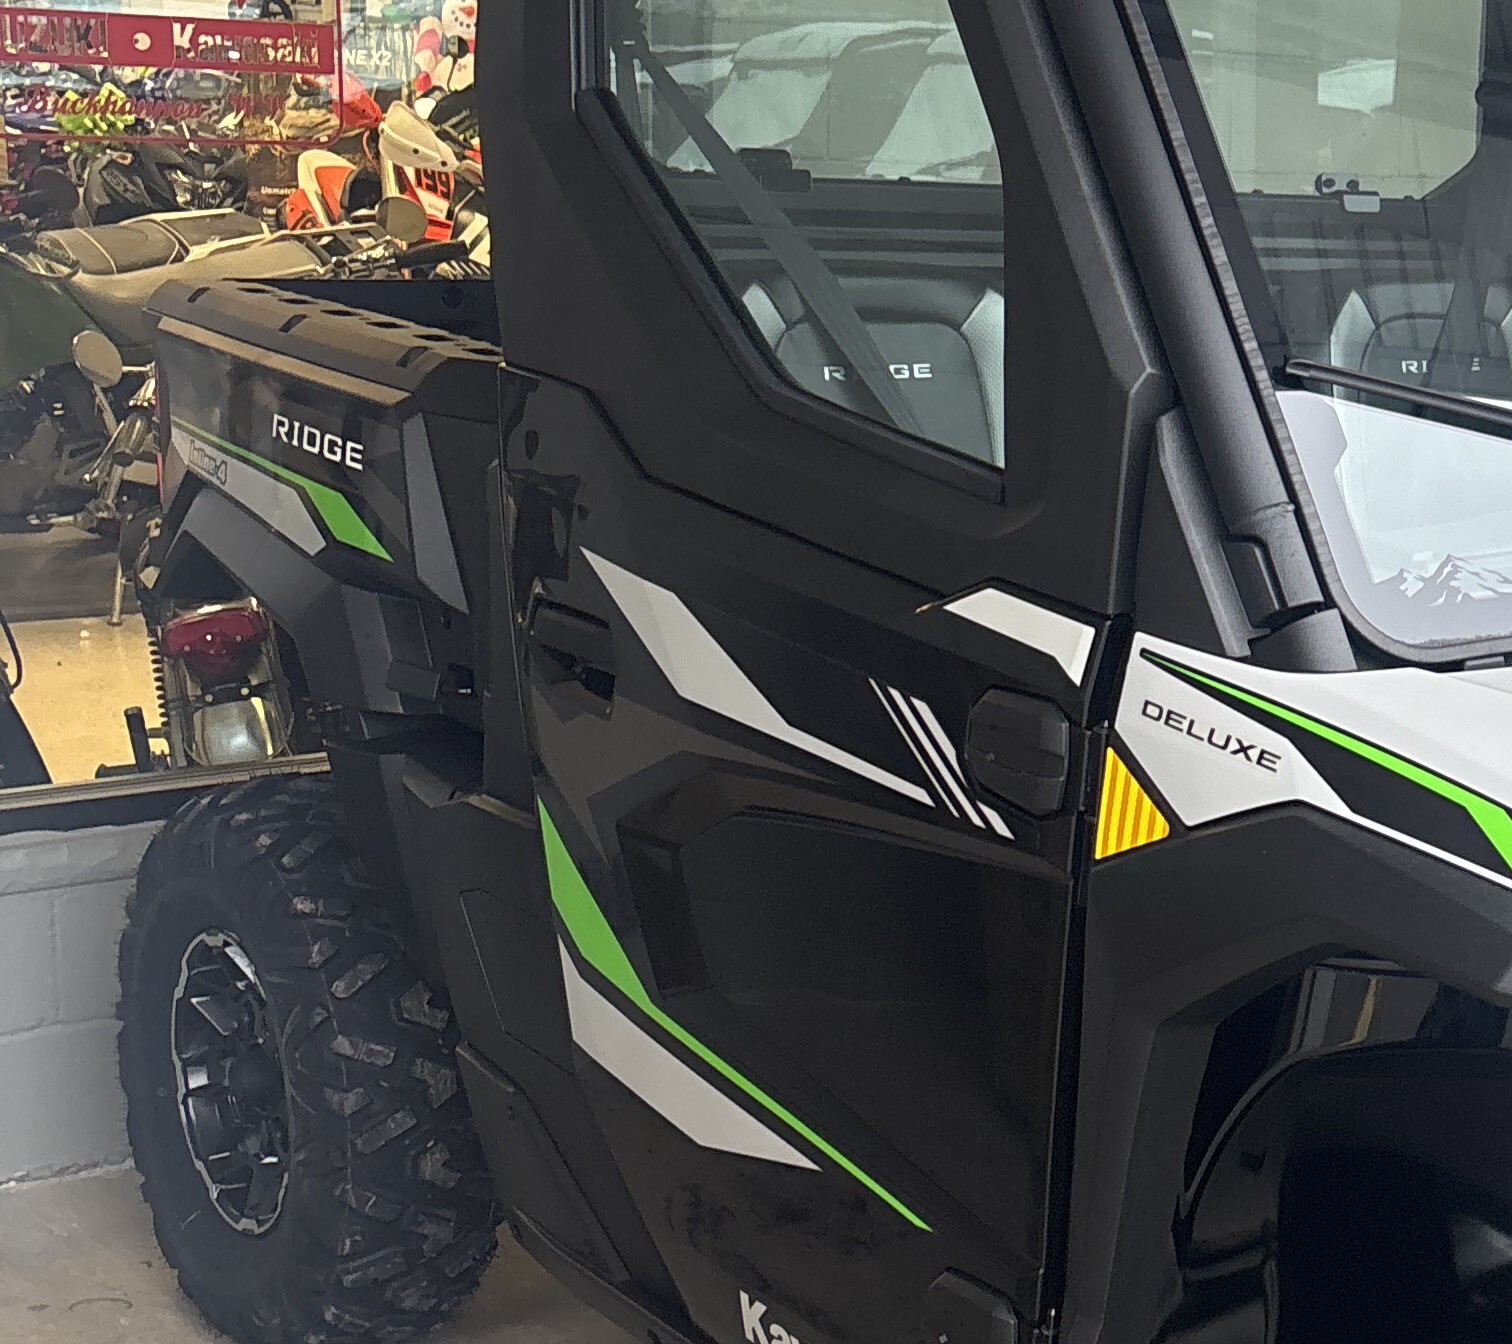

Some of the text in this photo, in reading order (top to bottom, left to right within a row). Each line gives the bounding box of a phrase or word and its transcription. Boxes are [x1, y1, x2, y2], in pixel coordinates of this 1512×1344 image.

[2, 12, 319, 65] UZUKI Kawasaki
[415, 167, 450, 201] 199
[823, 363, 933, 381] RGE
[1401, 358, 1481, 374] RIE
[271, 413, 364, 471] RIDGE
[1141, 699, 1282, 773] DELUXE
